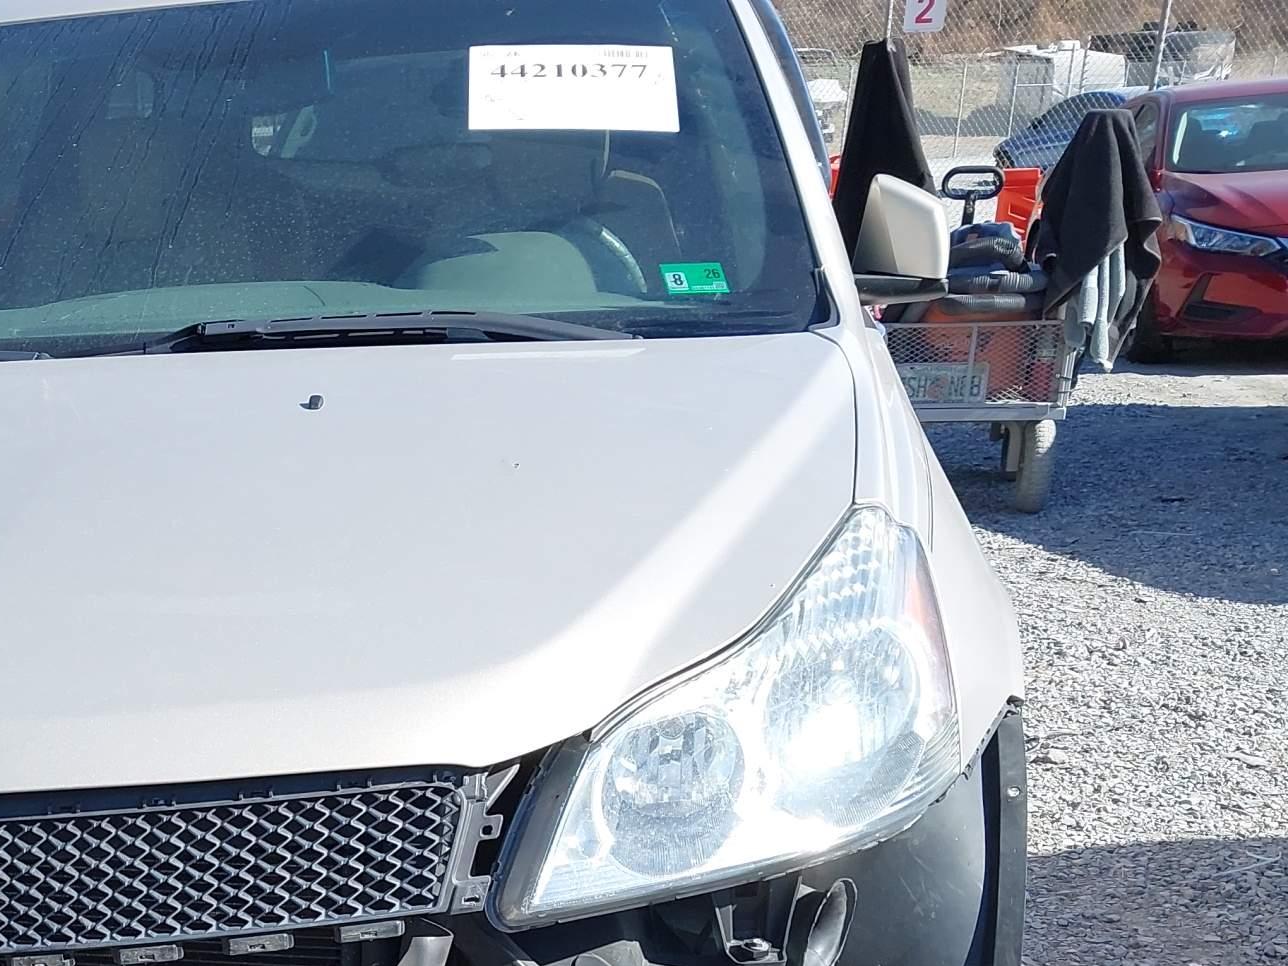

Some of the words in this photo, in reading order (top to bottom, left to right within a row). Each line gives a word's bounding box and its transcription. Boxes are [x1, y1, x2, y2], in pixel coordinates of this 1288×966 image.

[915, 0, 935, 24] 2
[490, 63, 648, 79] 44210377
[672, 273, 684, 286] 8
[704, 268, 721, 279] 26
